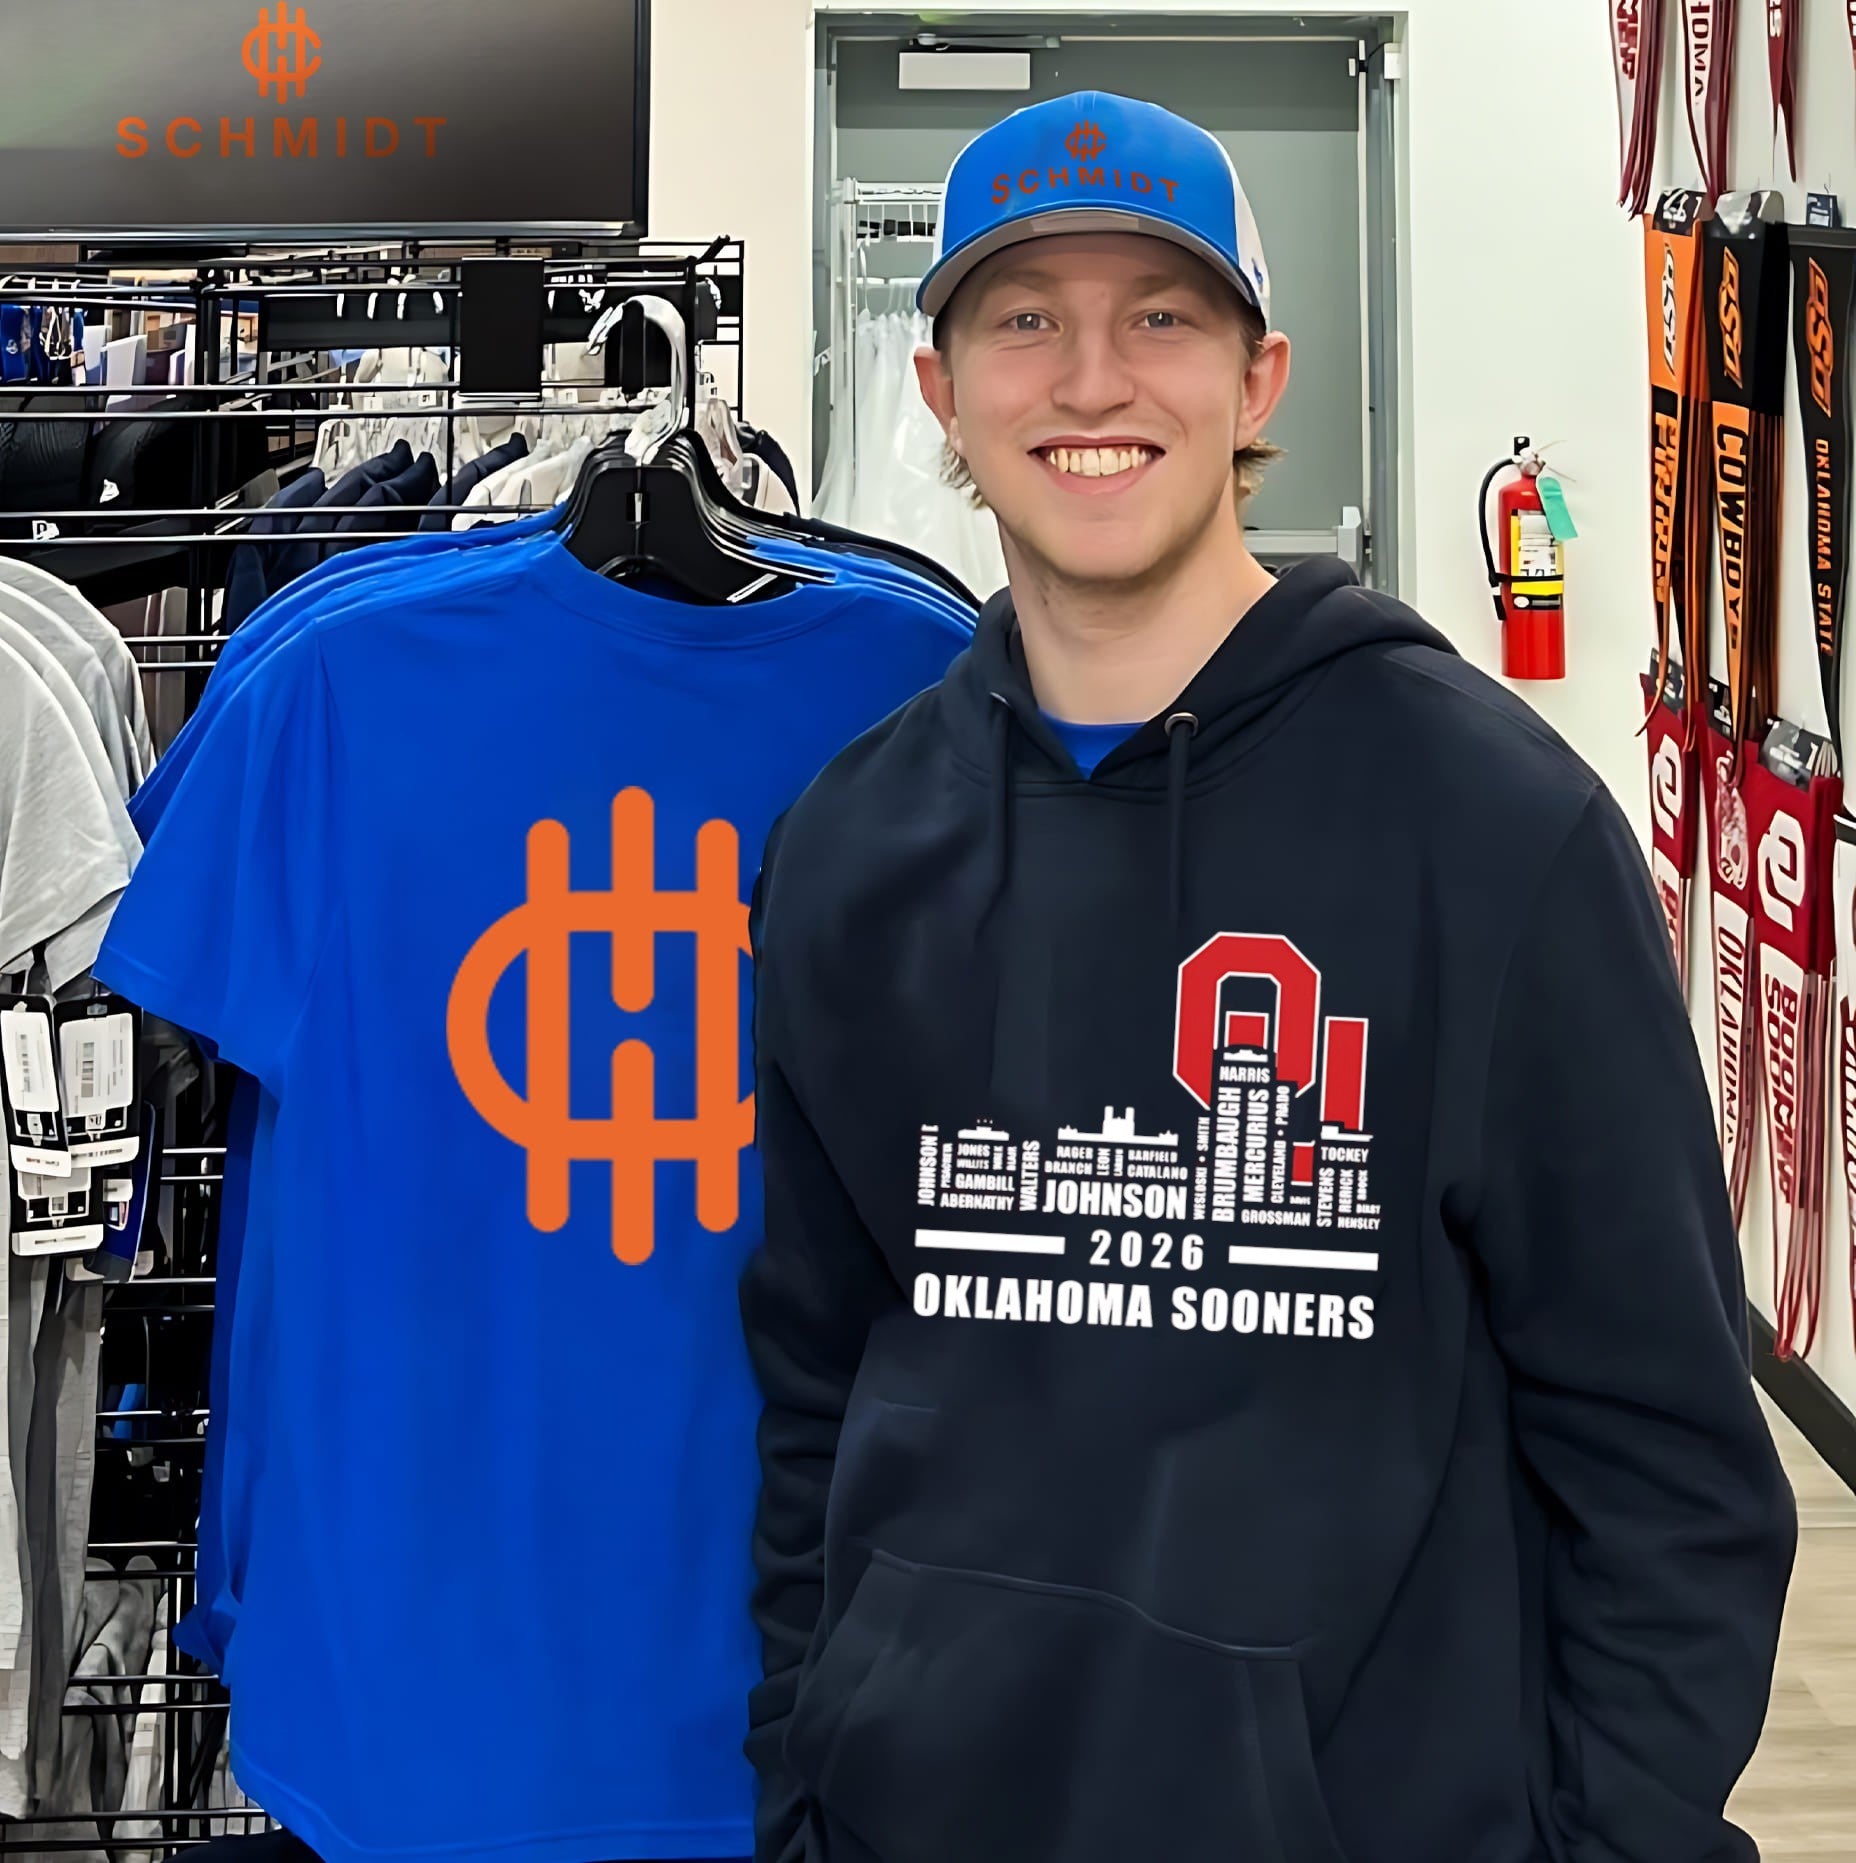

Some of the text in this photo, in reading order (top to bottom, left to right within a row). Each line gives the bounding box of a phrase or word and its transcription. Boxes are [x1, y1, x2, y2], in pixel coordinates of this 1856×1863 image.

[115, 116, 447, 159] SCHMIDT
[991, 167, 1179, 204] SCHMIDT
[1717, 925, 1746, 1144] OKLAHOMA
[1220, 1066, 1270, 1083] HARRIS
[957, 1144, 990, 1157] JONES
[1197, 1117, 1210, 1151] SMITH
[1243, 1089, 1269, 1202] MERCURIUS
[1271, 1086, 1290, 1203] CLEVELAND PRADO
[1045, 1161, 1092, 1175] BRANCH
[1057, 1146, 1093, 1159] RAGER
[1097, 1148, 1110, 1176] LEON
[1212, 1087, 1241, 1222] BRUMBAUGH
[1321, 1147, 1368, 1162] TOCKEY
[918, 1135, 938, 1206] JOHNSON
[955, 1173, 1015, 1191] GAMBILL
[1019, 1141, 1040, 1211] WALTERS
[1127, 1164, 1188, 1180] CATALANO
[940, 1193, 1014, 1210] ABERNATHY
[1042, 1180, 1187, 1220] JOHNSON
[1316, 1168, 1335, 1227] STEVENS
[1241, 1209, 1311, 1226] GROSSMAN
[1338, 1217, 1380, 1230] HENSLEY
[1090, 1229, 1203, 1270] 2026
[914, 1273, 1374, 1339] OKLAHOMA SOONERS
